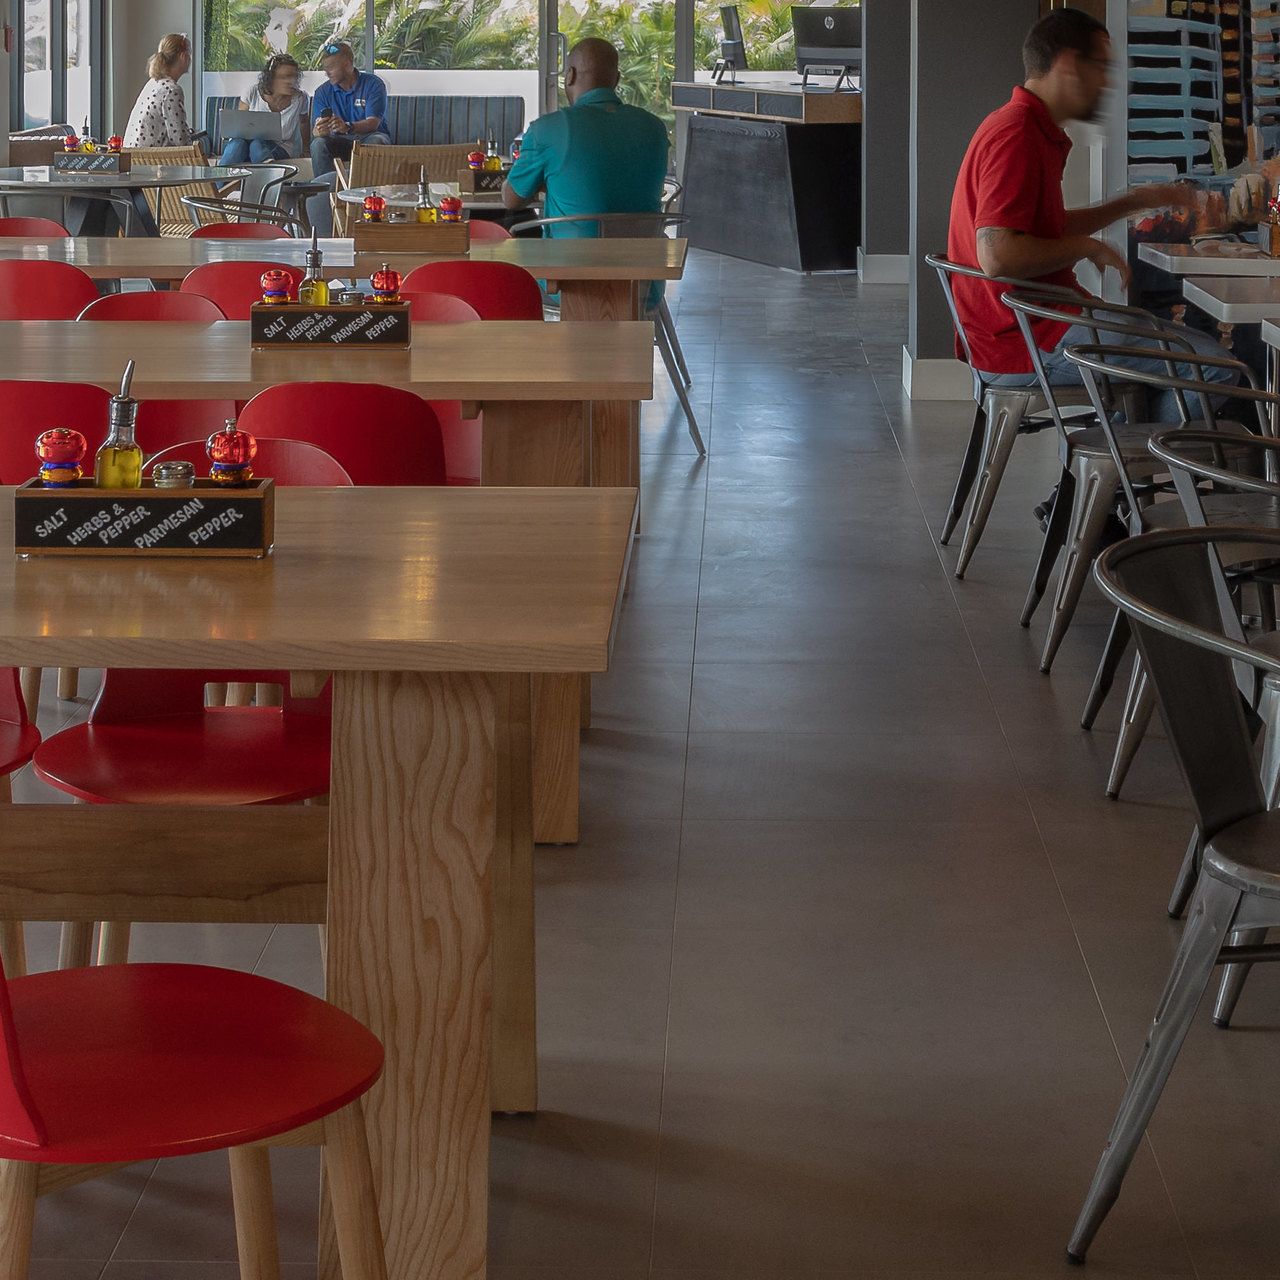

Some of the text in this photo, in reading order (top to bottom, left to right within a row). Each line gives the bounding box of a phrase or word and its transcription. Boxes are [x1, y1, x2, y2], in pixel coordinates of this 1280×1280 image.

[264, 316, 287, 338] SALT
[286, 312, 322, 341] HERBS &
[305, 314, 338, 341] PEPPER
[330, 311, 374, 344] PARMESAN
[365, 315, 398, 340] PEPPER
[34, 508, 69, 539] SALT
[67, 503, 125, 546] HERBS &
[98, 505, 152, 545] PEPPER
[134, 498, 204, 549] PARMESAN
[188, 507, 244, 546] PEPPER
